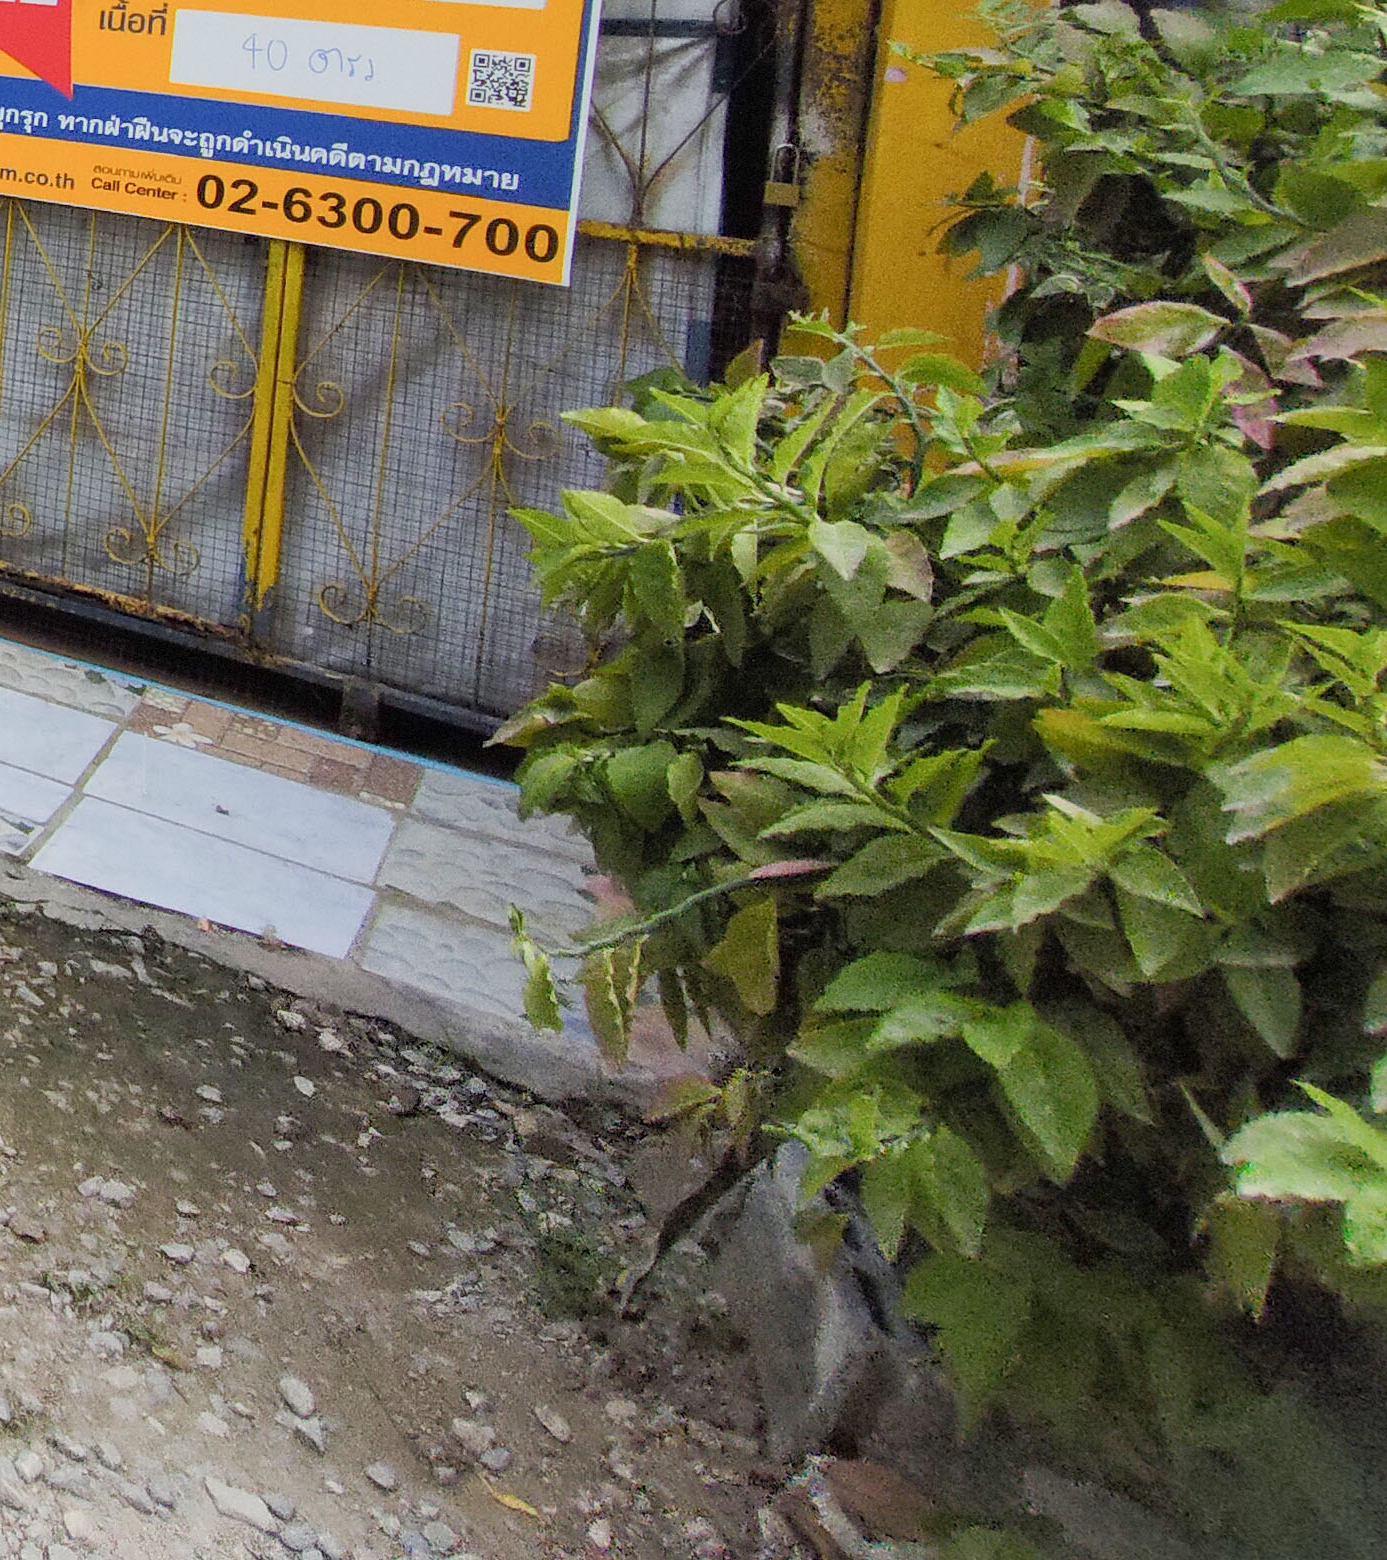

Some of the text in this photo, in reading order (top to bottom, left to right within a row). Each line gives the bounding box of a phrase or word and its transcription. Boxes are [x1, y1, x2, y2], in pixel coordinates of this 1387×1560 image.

[242, 33, 288, 72] 40
[91, 177, 121, 193] Call
[124, 182, 179, 201] Center
[196, 173, 560, 264] 02-6300-700
